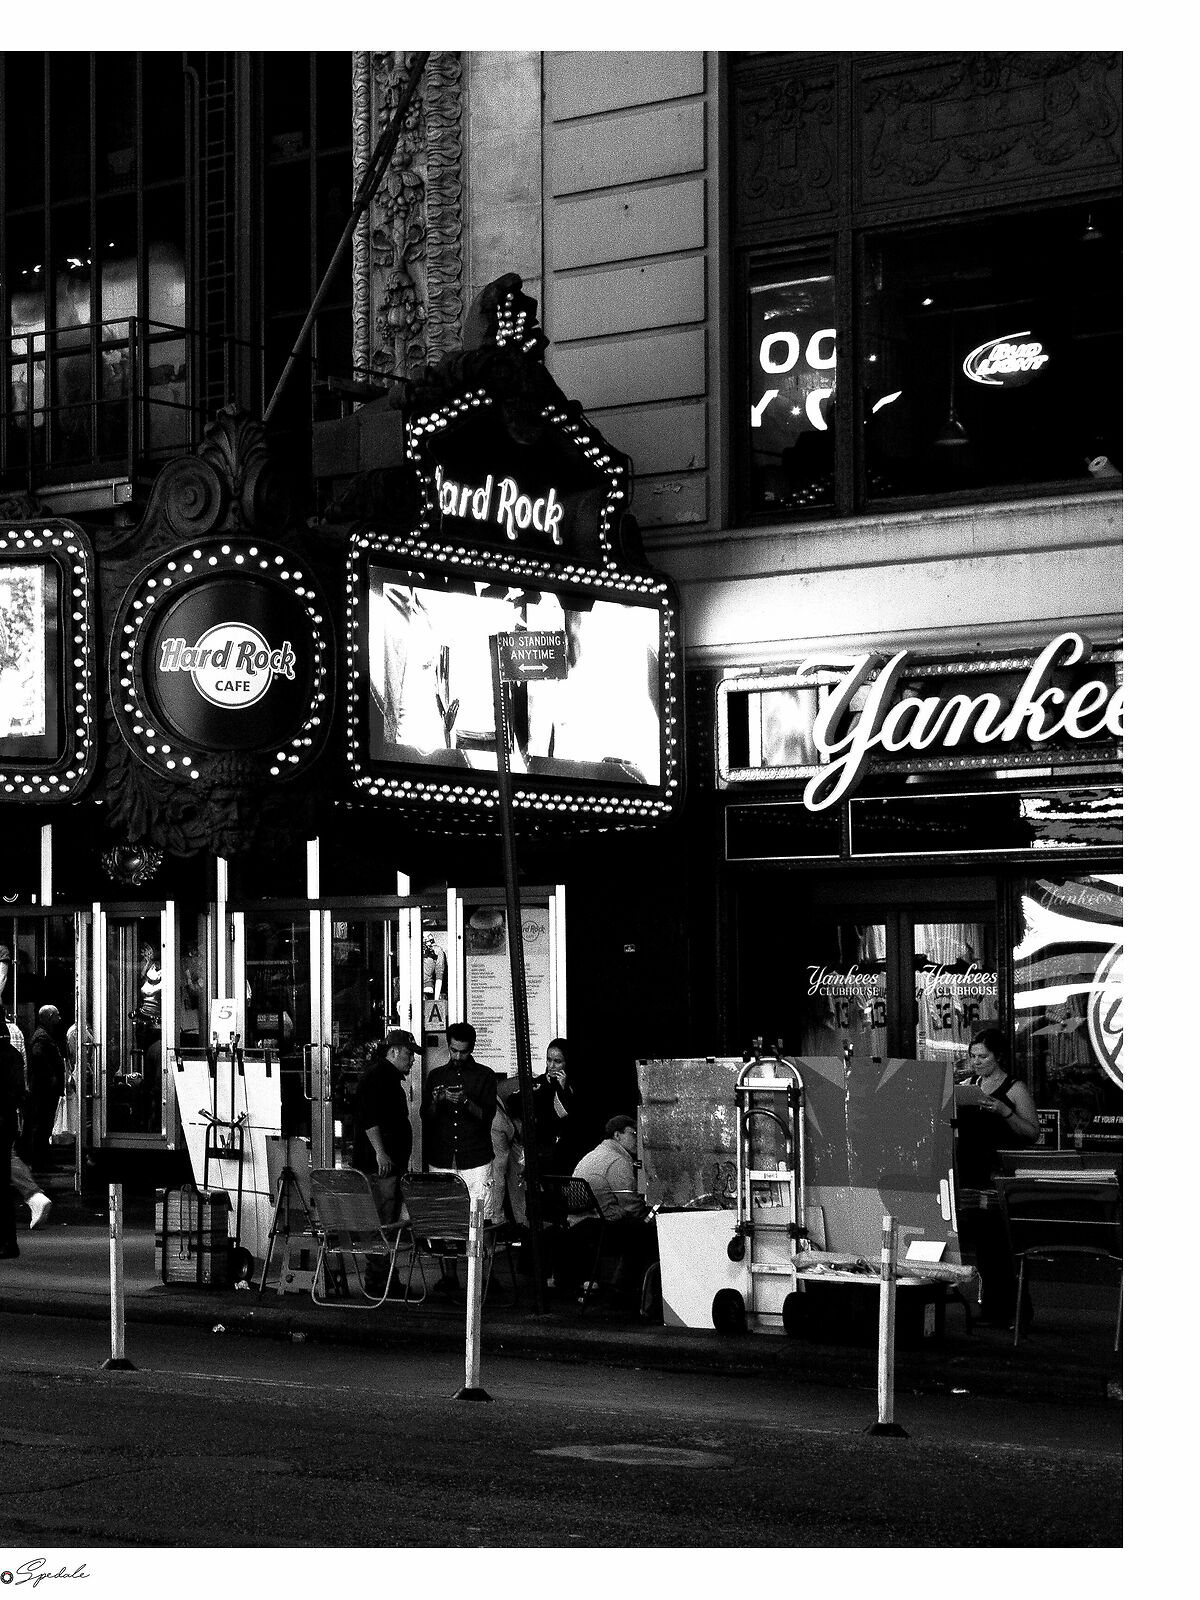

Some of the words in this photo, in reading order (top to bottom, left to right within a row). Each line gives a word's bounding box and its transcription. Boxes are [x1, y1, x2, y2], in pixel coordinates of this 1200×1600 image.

[497, 477, 564, 546] Rock
[502, 636, 515, 647] NO
[518, 636, 561, 647] STANDING
[160, 638, 234, 672] Hard
[235, 640, 297, 681] Rock
[510, 649, 555, 660] ANYTIME
[215, 680, 251, 692] CAFE
[806, 964, 880, 996] Yankees
[922, 963, 998, 996] Yankees
[819, 986, 879, 996] CLUBHOUSE
[936, 985, 998, 996] CLUBHOUSE
[429, 1003, 443, 1023] A
